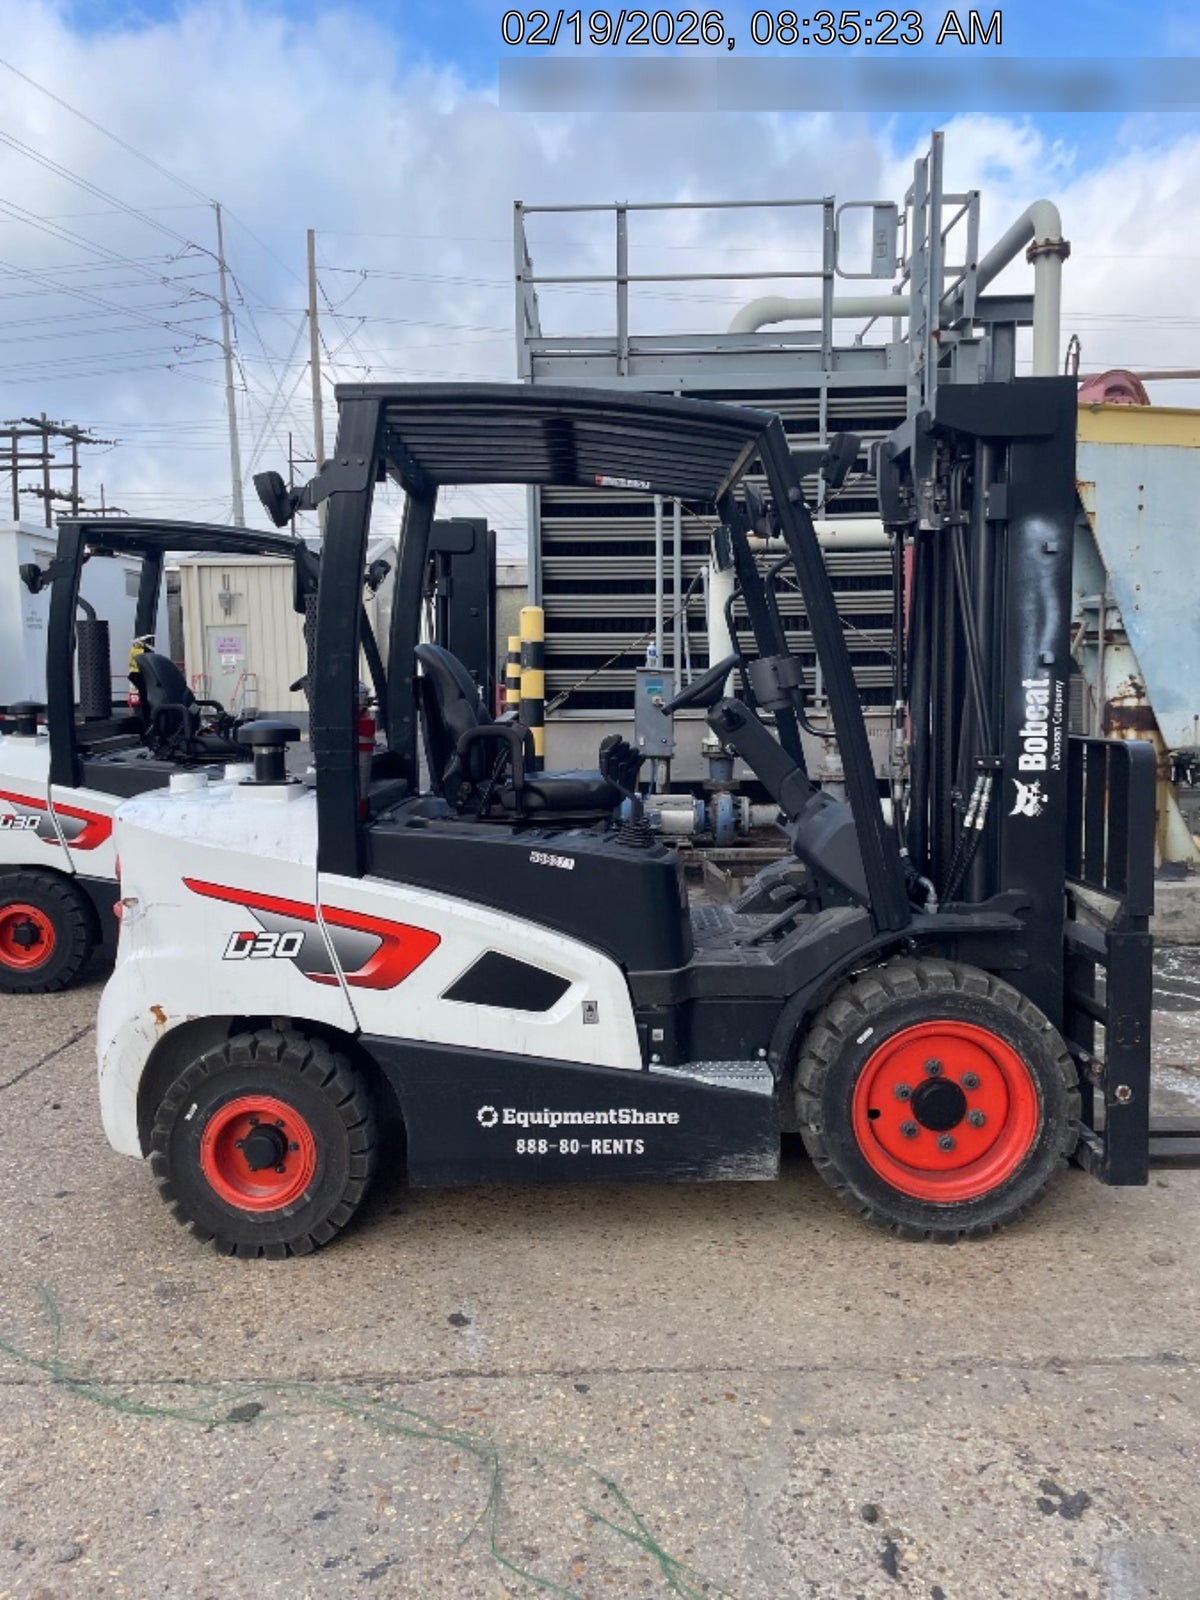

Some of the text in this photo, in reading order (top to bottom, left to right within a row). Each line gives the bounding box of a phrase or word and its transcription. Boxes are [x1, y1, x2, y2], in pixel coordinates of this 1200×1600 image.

[1019, 678, 1050, 771] Bobcat
[1051, 680, 1065, 771] A Doosan Company
[222, 930, 306, 960] D30
[502, 1108, 680, 1128] EquipmentShare
[516, 1138, 645, 1155] 888-80-RENTS
